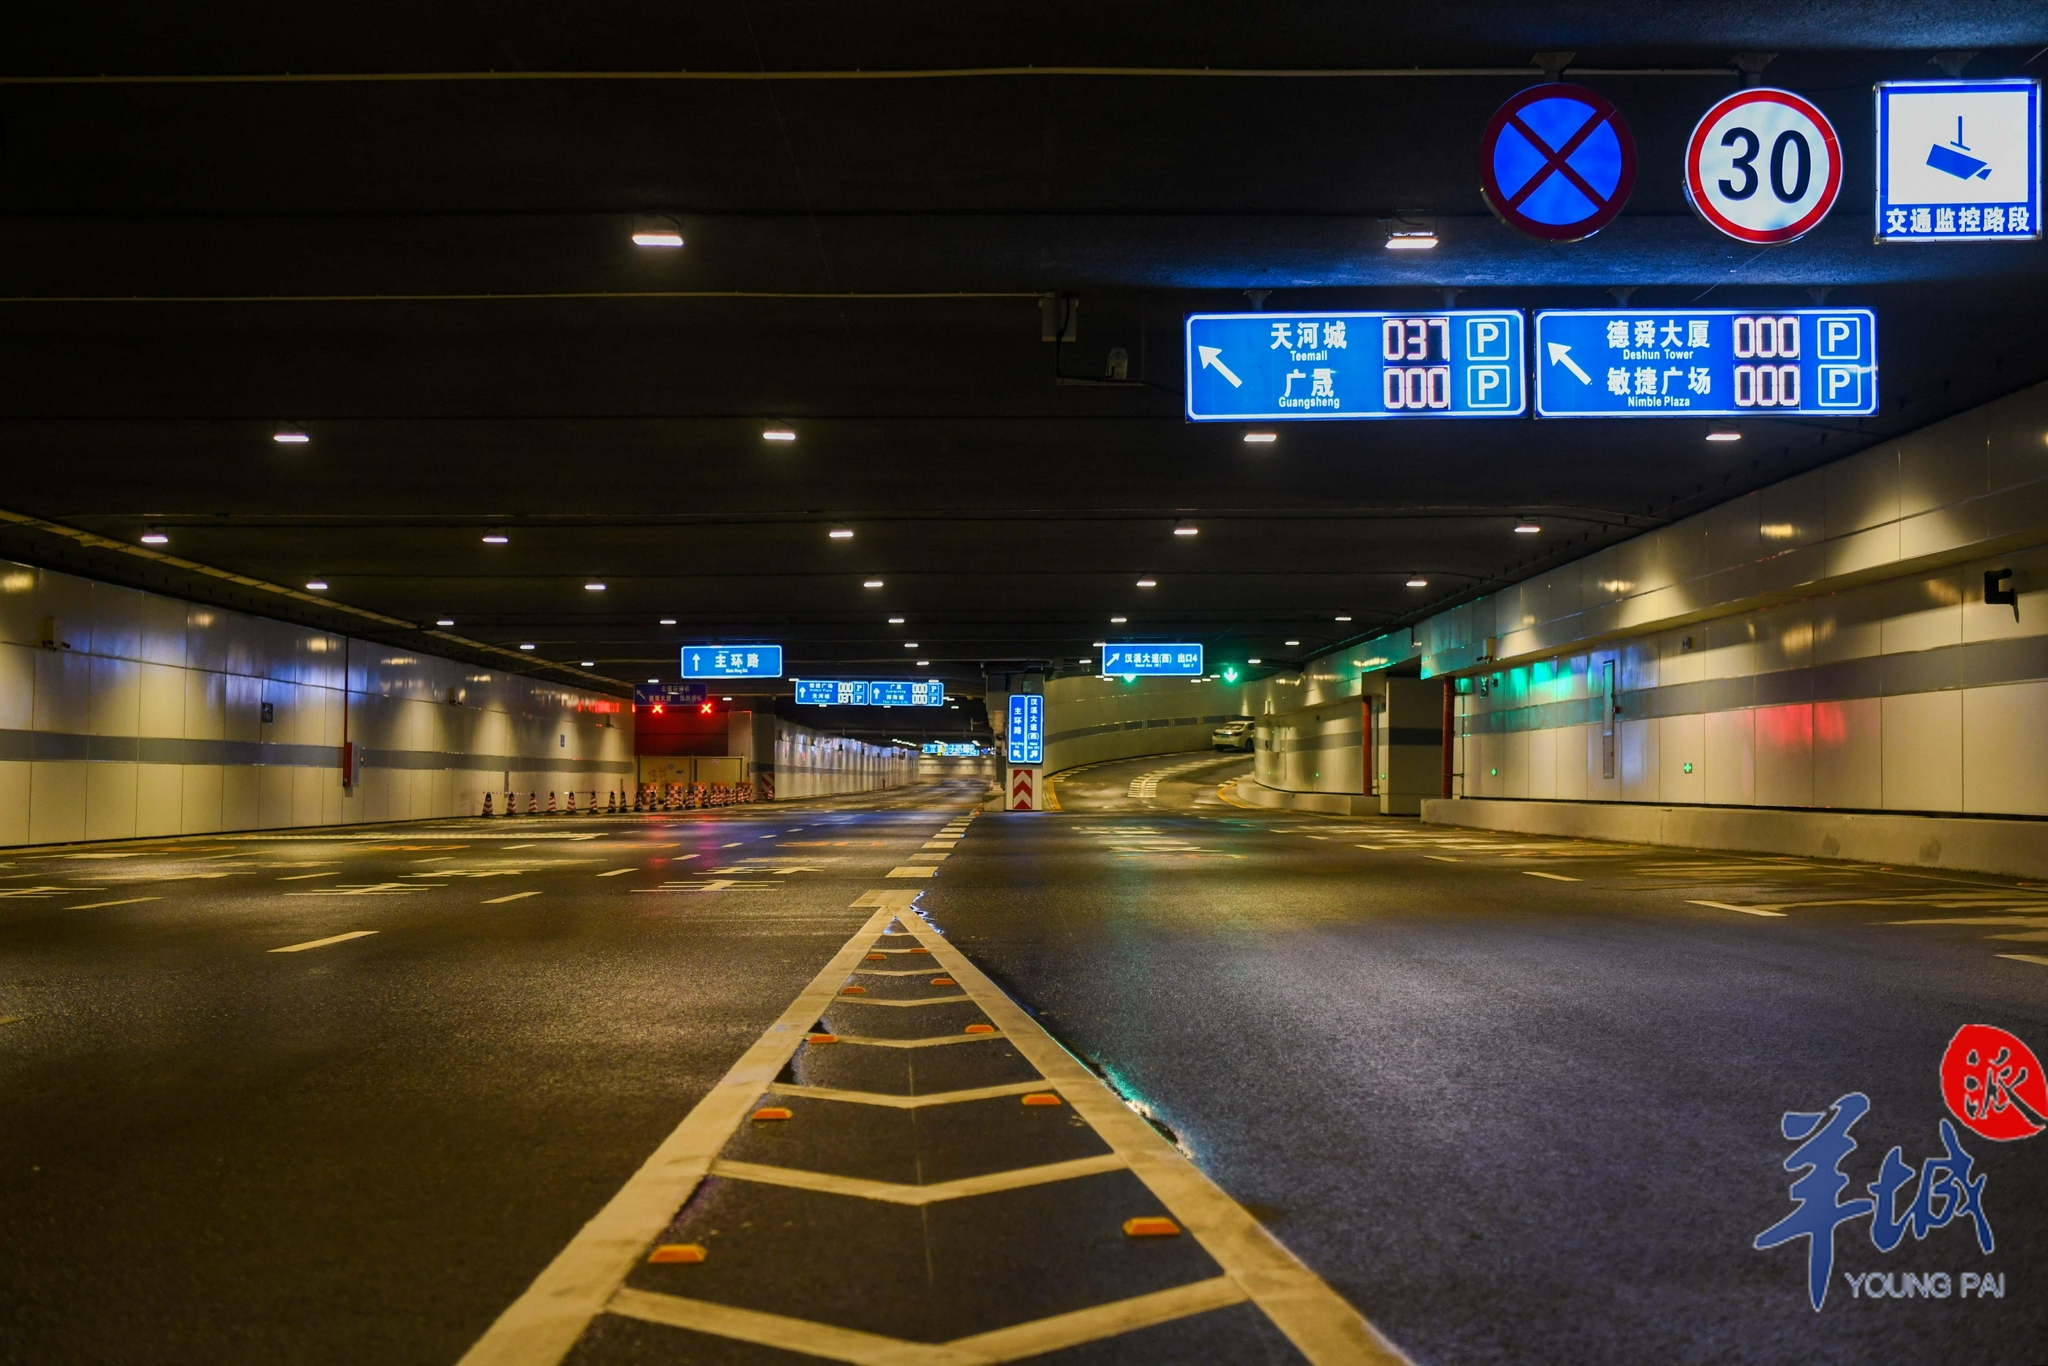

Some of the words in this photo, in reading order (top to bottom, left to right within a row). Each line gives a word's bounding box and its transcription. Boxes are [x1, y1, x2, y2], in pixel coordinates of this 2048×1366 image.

[1718, 126, 1812, 205] 30
[1886, 206, 2030, 234] 交通监控路段
[1270, 321, 1347, 350] 天河城
[1383, 319, 1449, 361] 037
[1477, 323, 1499, 353] P
[1606, 320, 1710, 349] 德舜大厦
[1734, 317, 1800, 359] 000
[1828, 322, 1850, 352] P
[1290, 350, 1328, 361] Teemall
[1623, 349, 1660, 361] Deshun
[1665, 349, 1693, 360] Tower
[1284, 369, 1335, 398] 广晟
[1384, 367, 1450, 409] 000
[1478, 370, 1500, 400] P
[1607, 367, 1711, 395] 敏捷广场
[1734, 365, 1801, 407] 000
[1829, 369, 1851, 399] P
[1278, 396, 1340, 409] Guangsheng
[1628, 396, 1662, 407] Nimble
[1664, 396, 1690, 407] Plaza
[715, 653, 759, 668] 主环路
[1178, 653, 1198, 663] 出口4
[1014, 706, 1022, 734] 主环路
